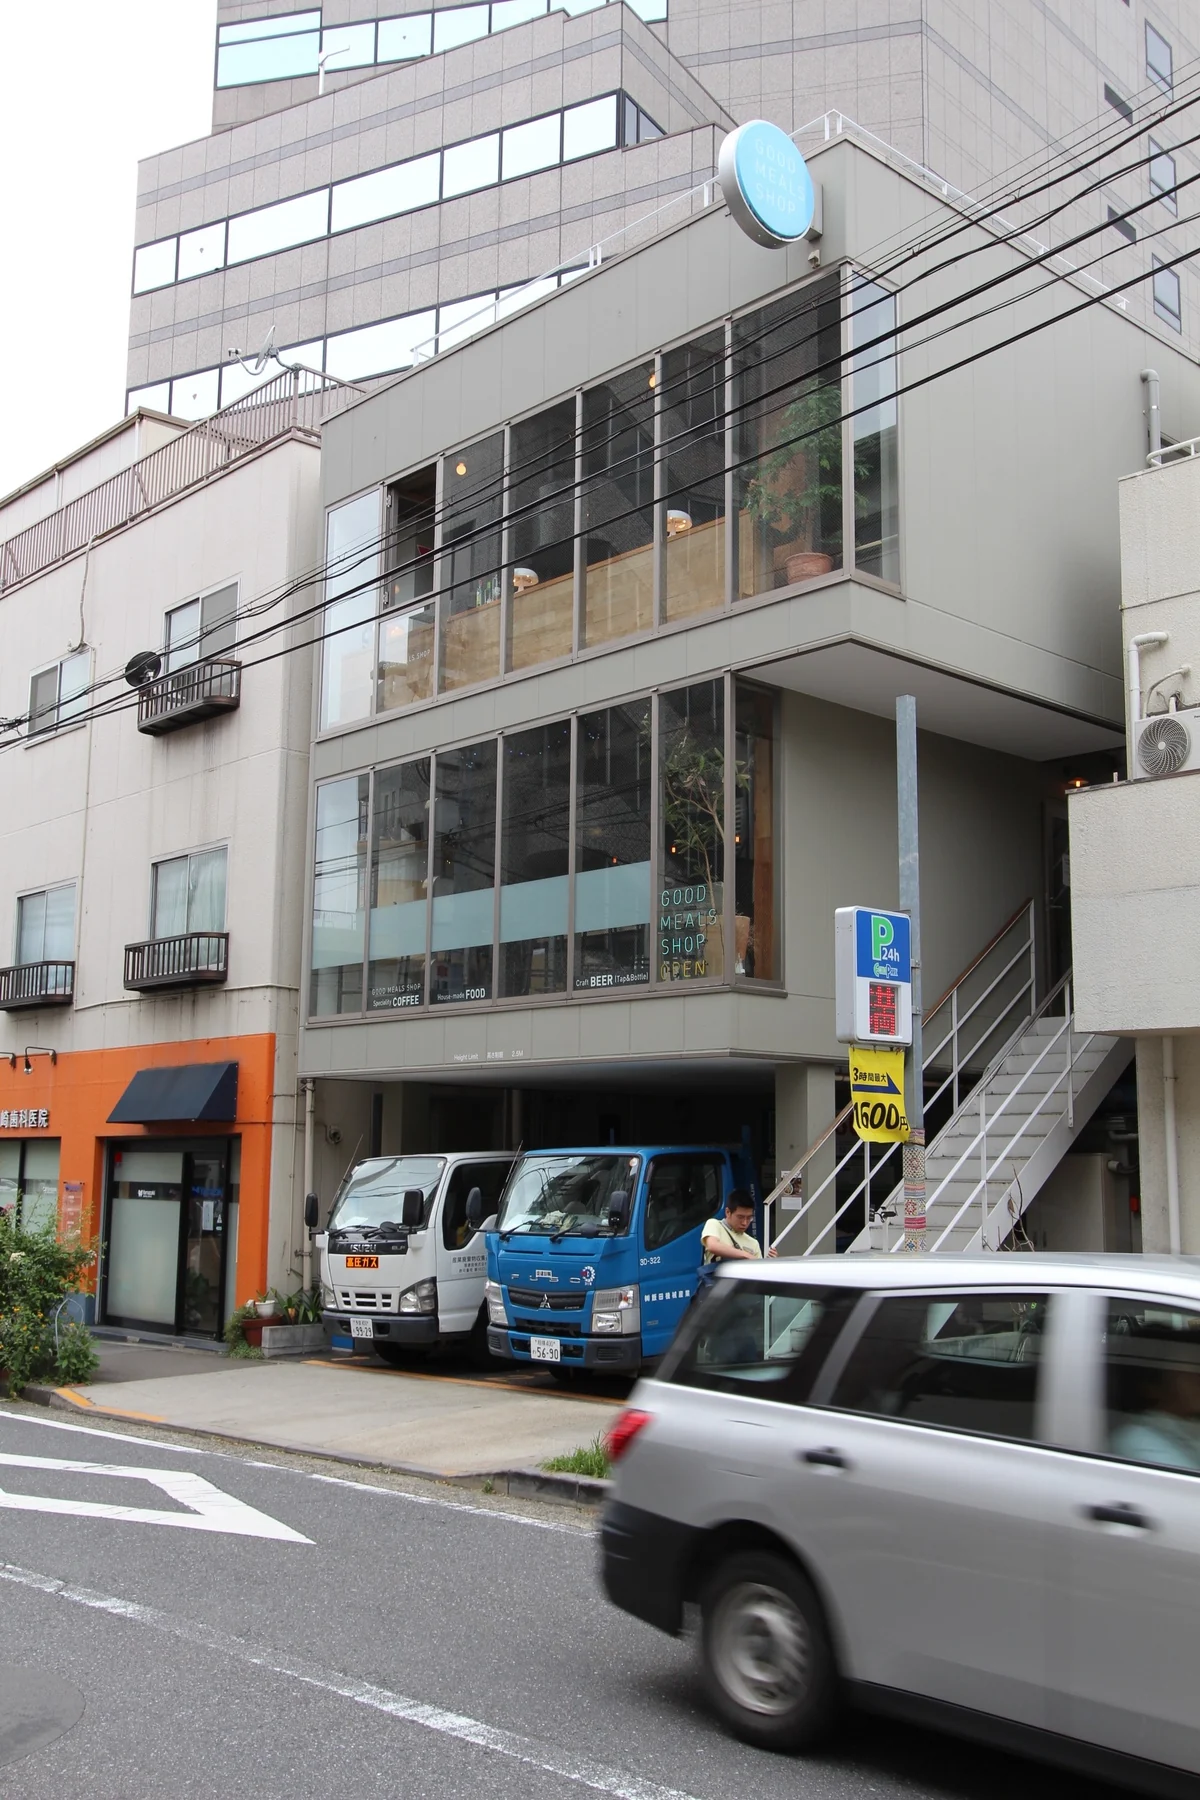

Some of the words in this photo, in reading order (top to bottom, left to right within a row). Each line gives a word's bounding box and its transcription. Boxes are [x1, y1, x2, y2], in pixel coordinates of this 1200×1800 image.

[755, 138, 797, 174] GOOD
[755, 161, 806, 202] MEALS
[755, 182, 796, 215] SHOP
[661, 885, 706, 907] GOOD
[660, 908, 717, 930] MEALS
[661, 933, 705, 955] SHOP
[871, 914, 894, 961] P
[882, 947, 900, 962] 24h
[660, 960, 706, 980] OPEN
[575, 979, 589, 987] Craft
[590, 974, 613, 987] BEER
[371, 987, 387, 996] GOOD
[387, 984, 405, 994] MEALS
[406, 982, 421, 992] SHOP
[465, 988, 486, 1000] FOOD
[392, 994, 420, 1007] COFFEE
[852, 1067, 887, 1083] 3時間最大
[350, 1244, 377, 1252] ISUZU
[346, 1257, 378, 1268] 高圧ガス
[639, 1256, 661, 1266] 30-322
[537, 1346, 559, 1360] 56-90
